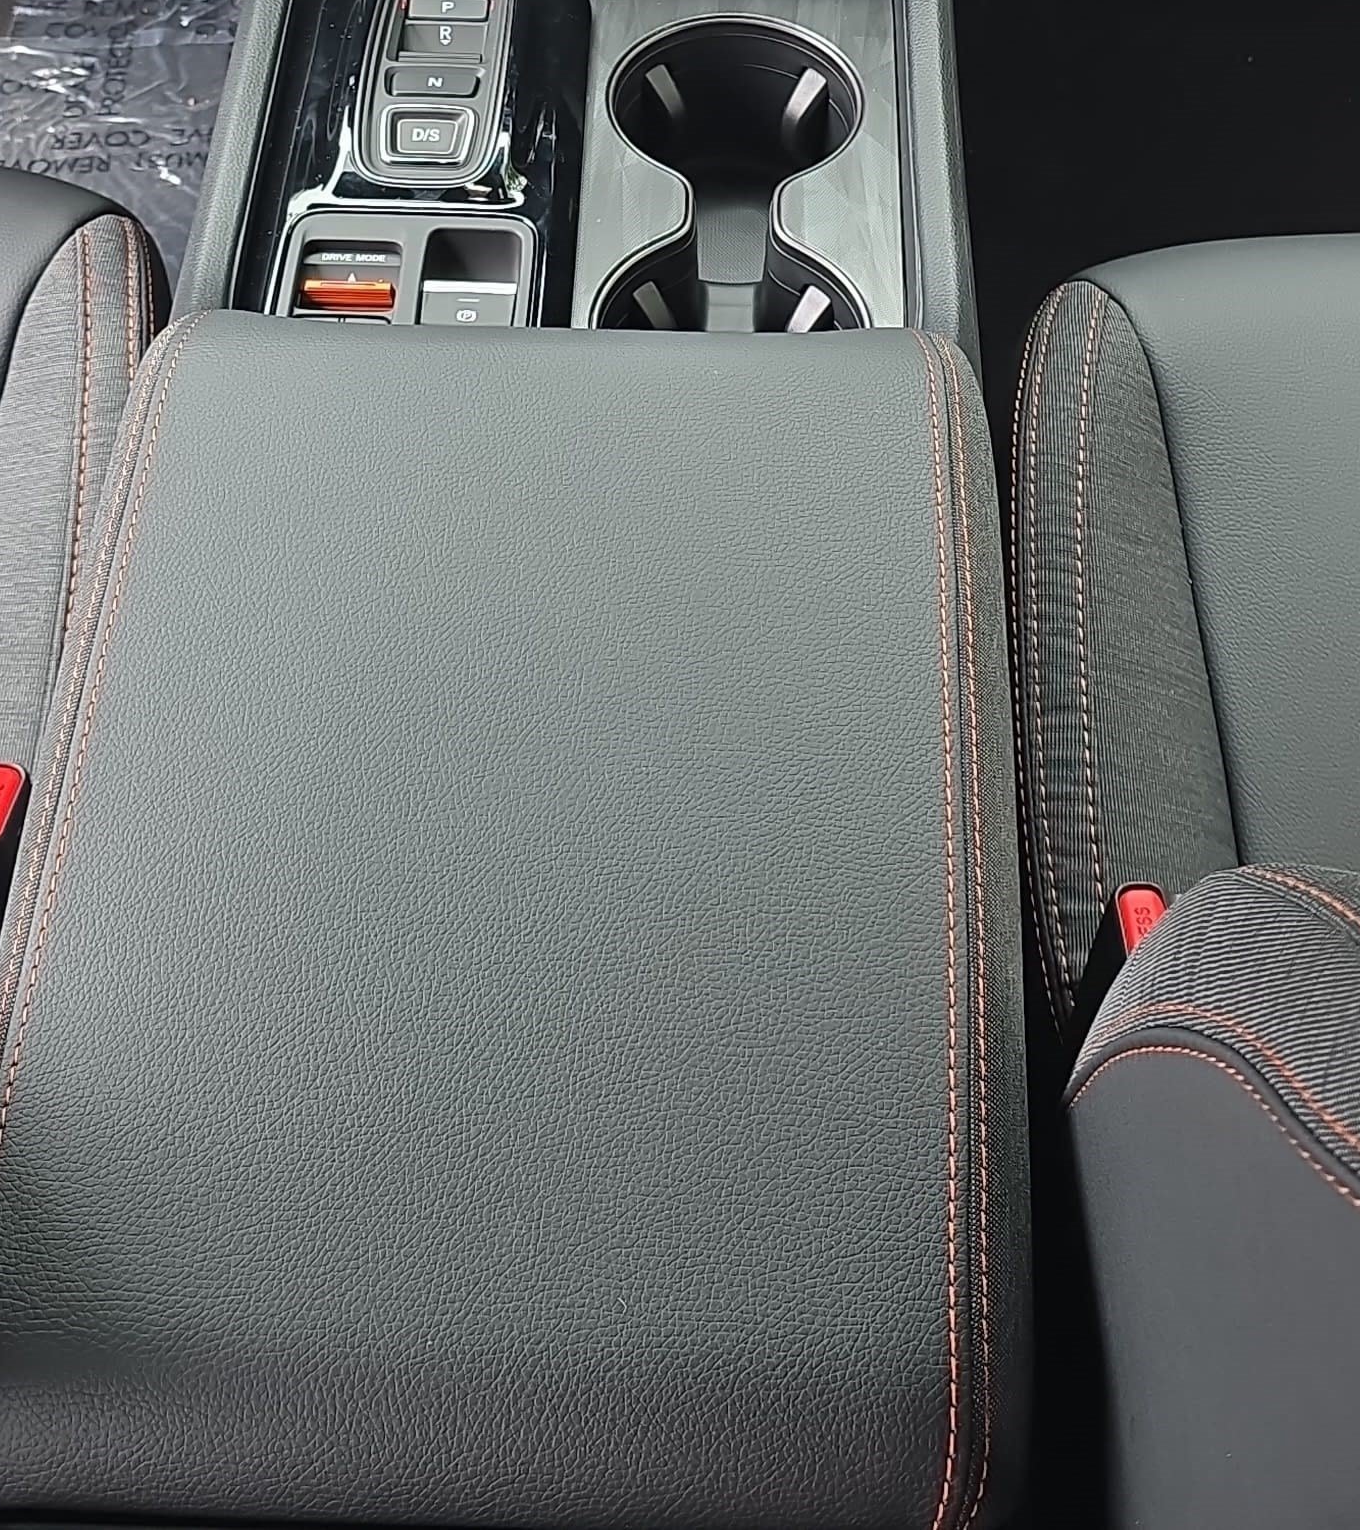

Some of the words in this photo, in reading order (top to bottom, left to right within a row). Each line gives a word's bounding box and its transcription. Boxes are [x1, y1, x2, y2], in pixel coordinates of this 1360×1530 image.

[441, 1, 455, 13] P
[439, 26, 452, 41] R
[428, 76, 444, 87] N
[52, 128, 151, 152] COVER
[411, 126, 440, 143] D/S
[321, 253, 353, 262] DRIVE
[355, 254, 386, 263] MODE
